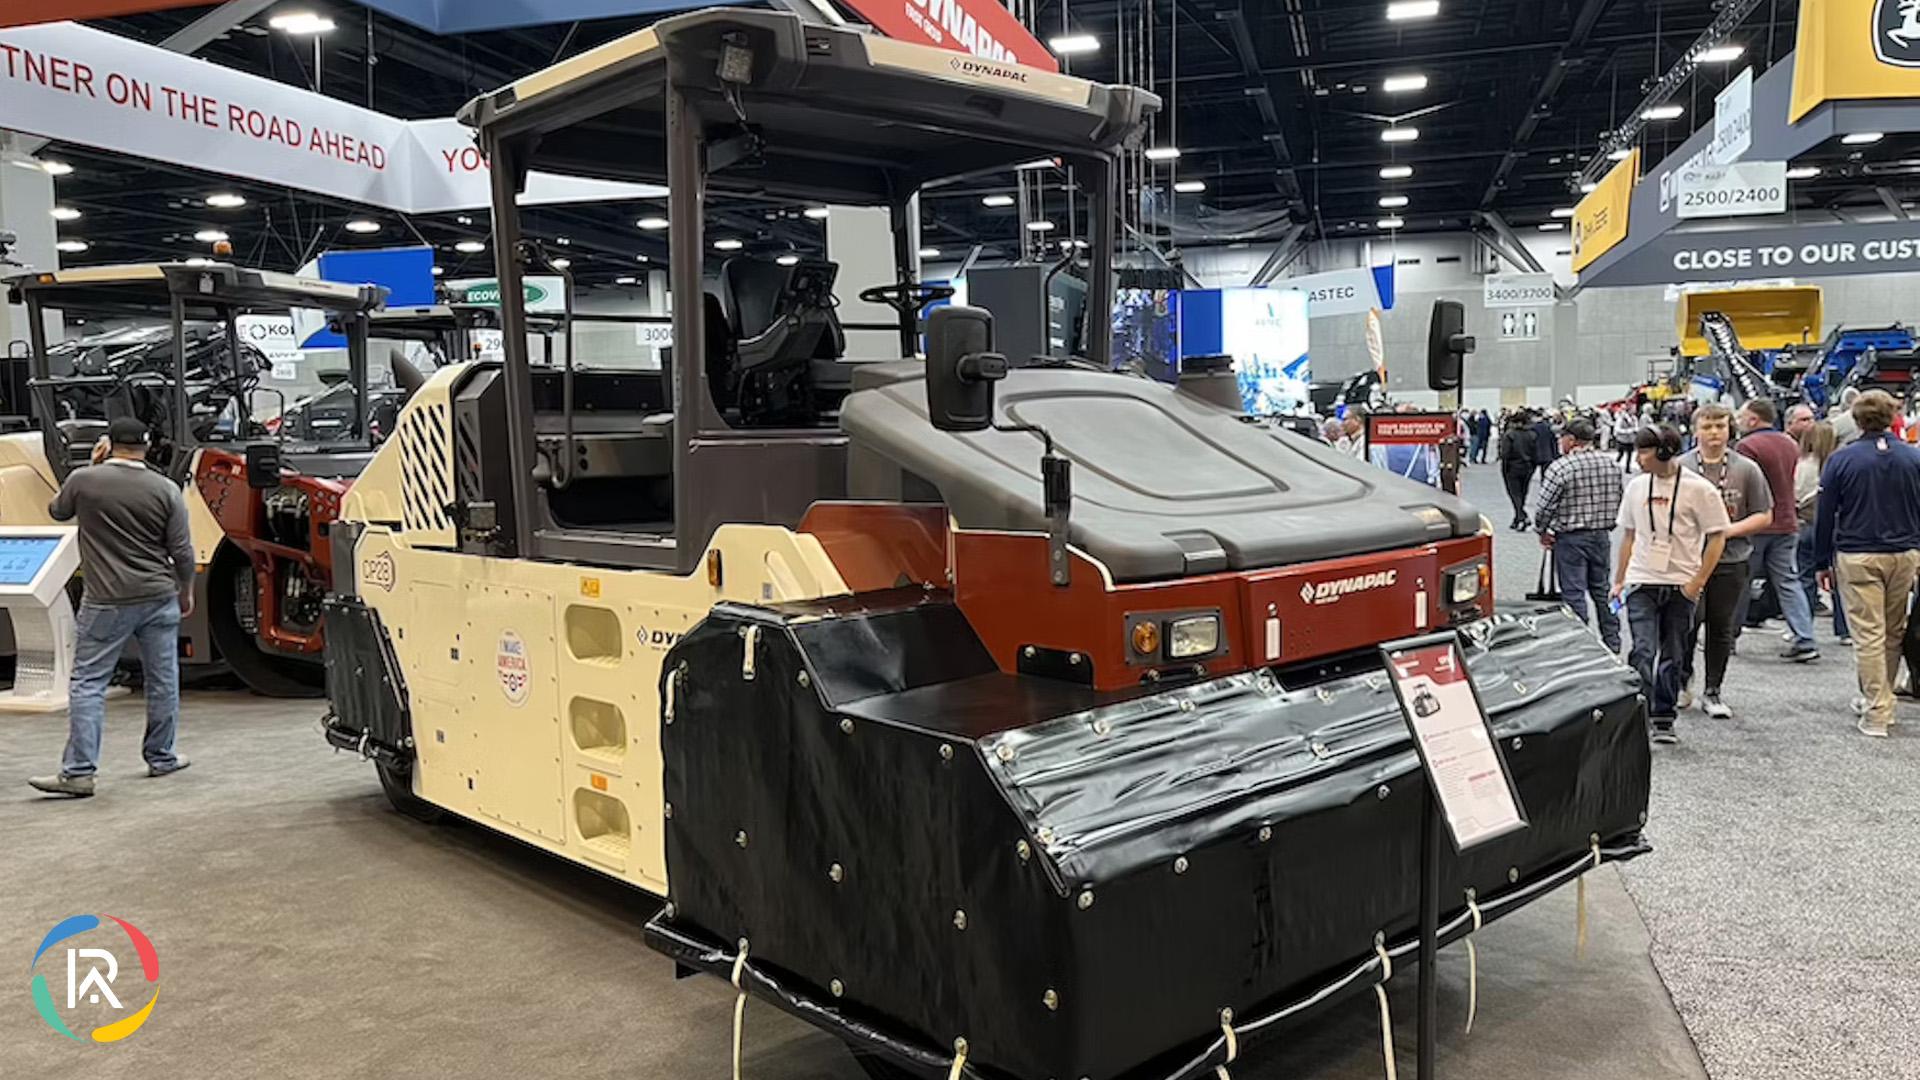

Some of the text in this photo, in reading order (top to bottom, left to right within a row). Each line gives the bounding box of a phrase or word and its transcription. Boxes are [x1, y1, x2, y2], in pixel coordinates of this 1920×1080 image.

[963, 62, 1028, 83] DYNAPAC
[107, 73, 151, 111] ON
[161, 86, 218, 128] THE
[228, 104, 302, 147] ROAD
[310, 127, 385, 170] AHEAD
[442, 147, 495, 172] YO
[1684, 187, 1780, 206] 2500/2400
[1673, 249, 1751, 270] CLOSE
[1758, 246, 1794, 265] TO
[1800, 243, 1856, 264] OUR
[1308, 286, 1354, 301] ASTEC
[1487, 287, 1551, 300] 3400/3700
[362, 559, 390, 582] CP28
[1314, 569, 1396, 599] DYNAPAC
